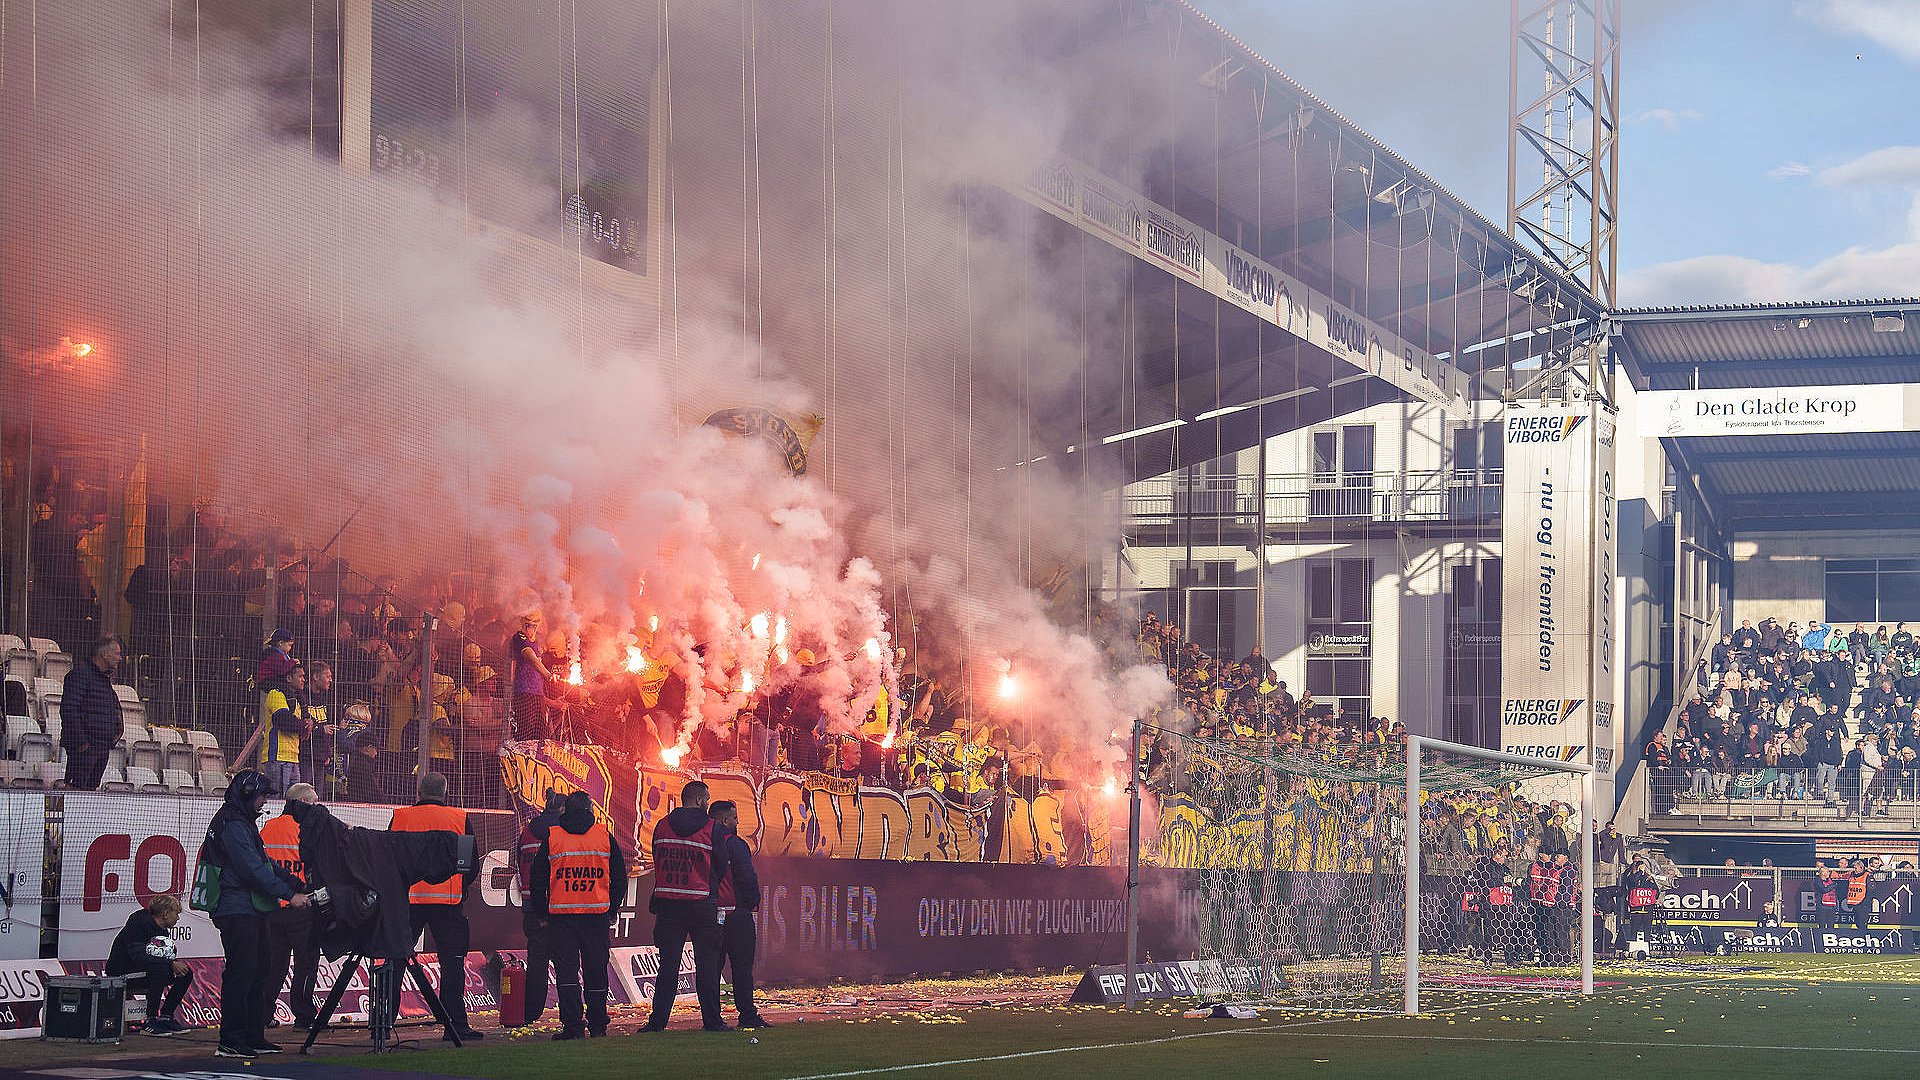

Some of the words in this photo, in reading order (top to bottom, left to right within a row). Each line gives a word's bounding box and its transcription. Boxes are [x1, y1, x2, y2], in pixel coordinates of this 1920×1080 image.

[1226, 249, 1274, 307] VIBOCOLD
[1326, 304, 1367, 355] VIBOCOLD
[1696, 401, 1734, 416] Den
[1741, 398, 1799, 415] Glade
[1805, 397, 1856, 417] Krop
[1508, 416, 1564, 429] ENERGI
[1508, 430, 1560, 443] VIBORG
[1541, 482, 1552, 510] nu
[1537, 517, 1552, 545] og
[1539, 565, 1556, 672] fremtiden
[1505, 700, 1560, 712] ENERGI
[1504, 713, 1557, 726] VIBORG
[1505, 745, 1560, 758] ENERGI
[556, 866, 605, 880] STEWARD
[564, 880, 596, 893] 1657
[1660, 890, 1720, 909] ach
[800, 885, 878, 950] BILER
[918, 897, 965, 937] OPLEV
[970, 899, 1000, 936] DEN
[1005, 899, 1033, 935] NYE
[1700, 911, 1720, 920] A/S
[1822, 933, 1881, 948] Bach
[463, 989, 496, 1011] ylland
